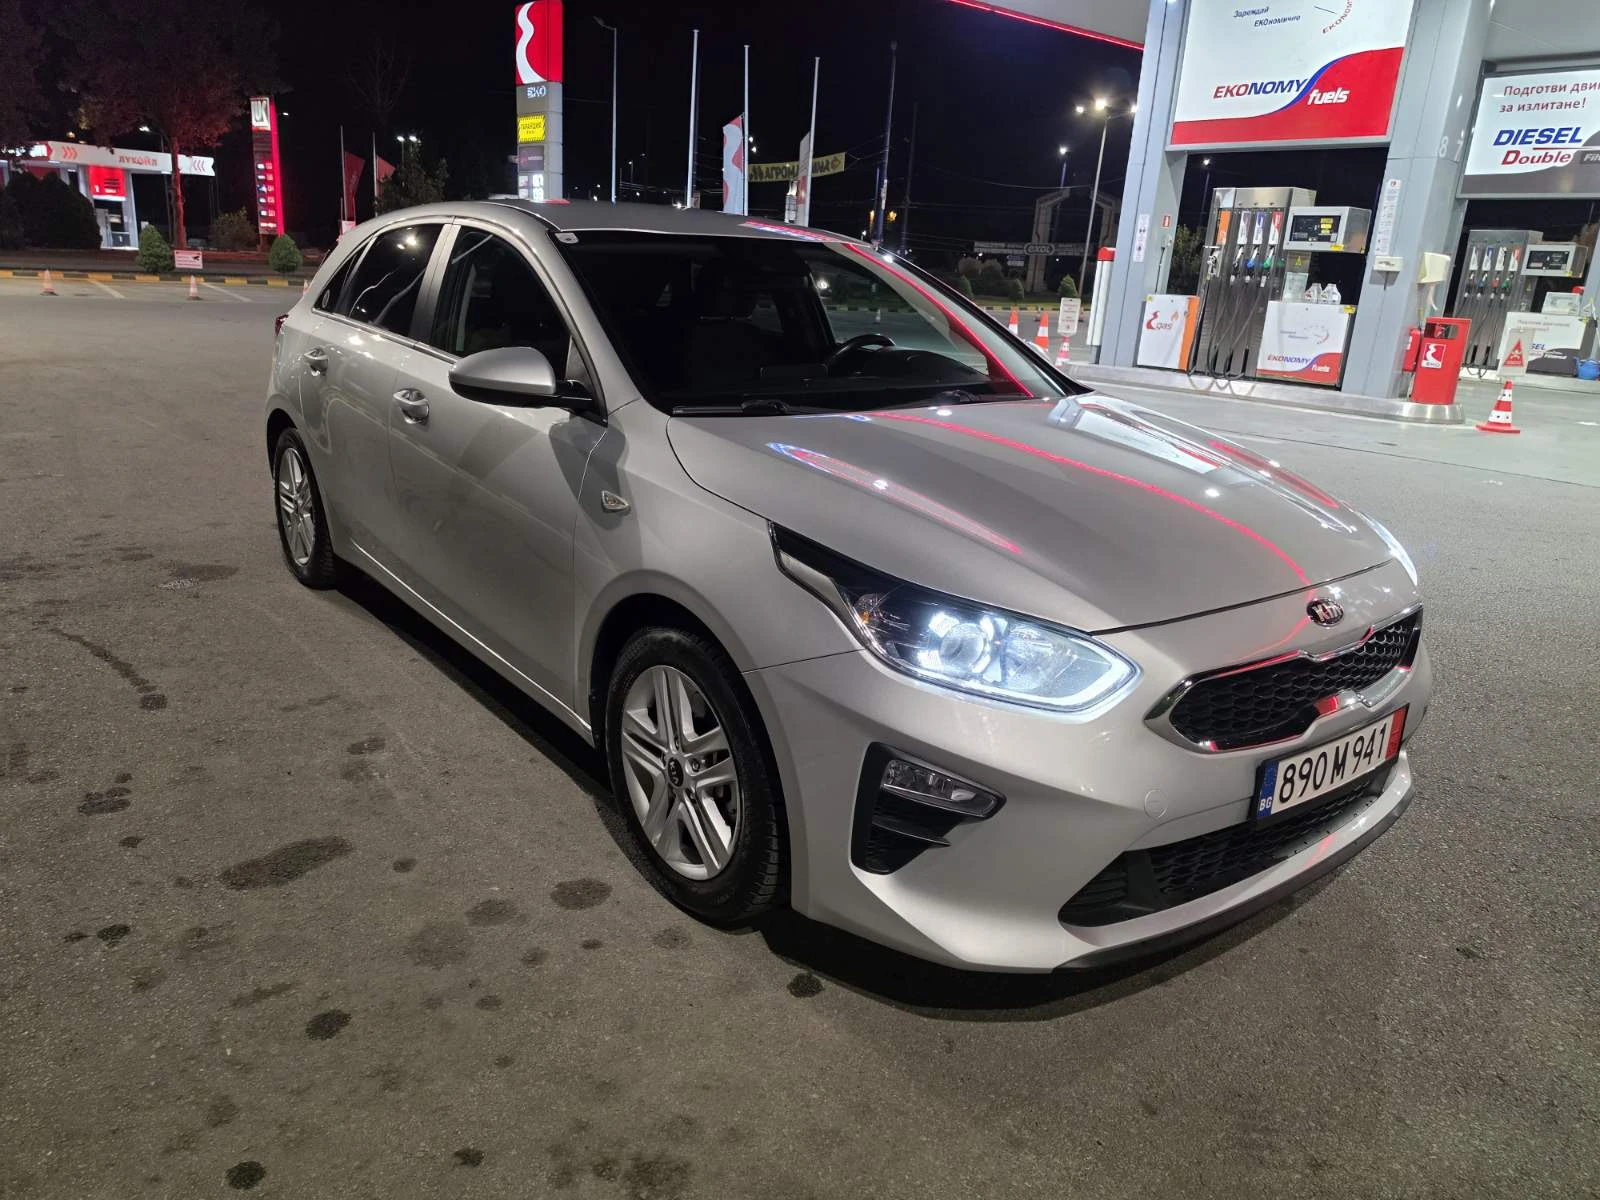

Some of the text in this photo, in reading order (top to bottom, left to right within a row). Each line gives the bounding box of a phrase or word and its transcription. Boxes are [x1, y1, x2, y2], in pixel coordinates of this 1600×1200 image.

[1322, 0, 1353, 34] EKONOM
[1213, 79, 1308, 99] EKONOMY
[1307, 87, 1351, 105] fuels
[1503, 85, 1568, 97] Подготви
[1499, 98, 1587, 113] за излитане!
[1493, 127, 1583, 146] DIESEL
[1439, 136, 1449, 158] 8
[1501, 150, 1571, 165] Double
[1279, 722, 1388, 803] 890 M 941
[1259, 795, 1273, 811] BG
